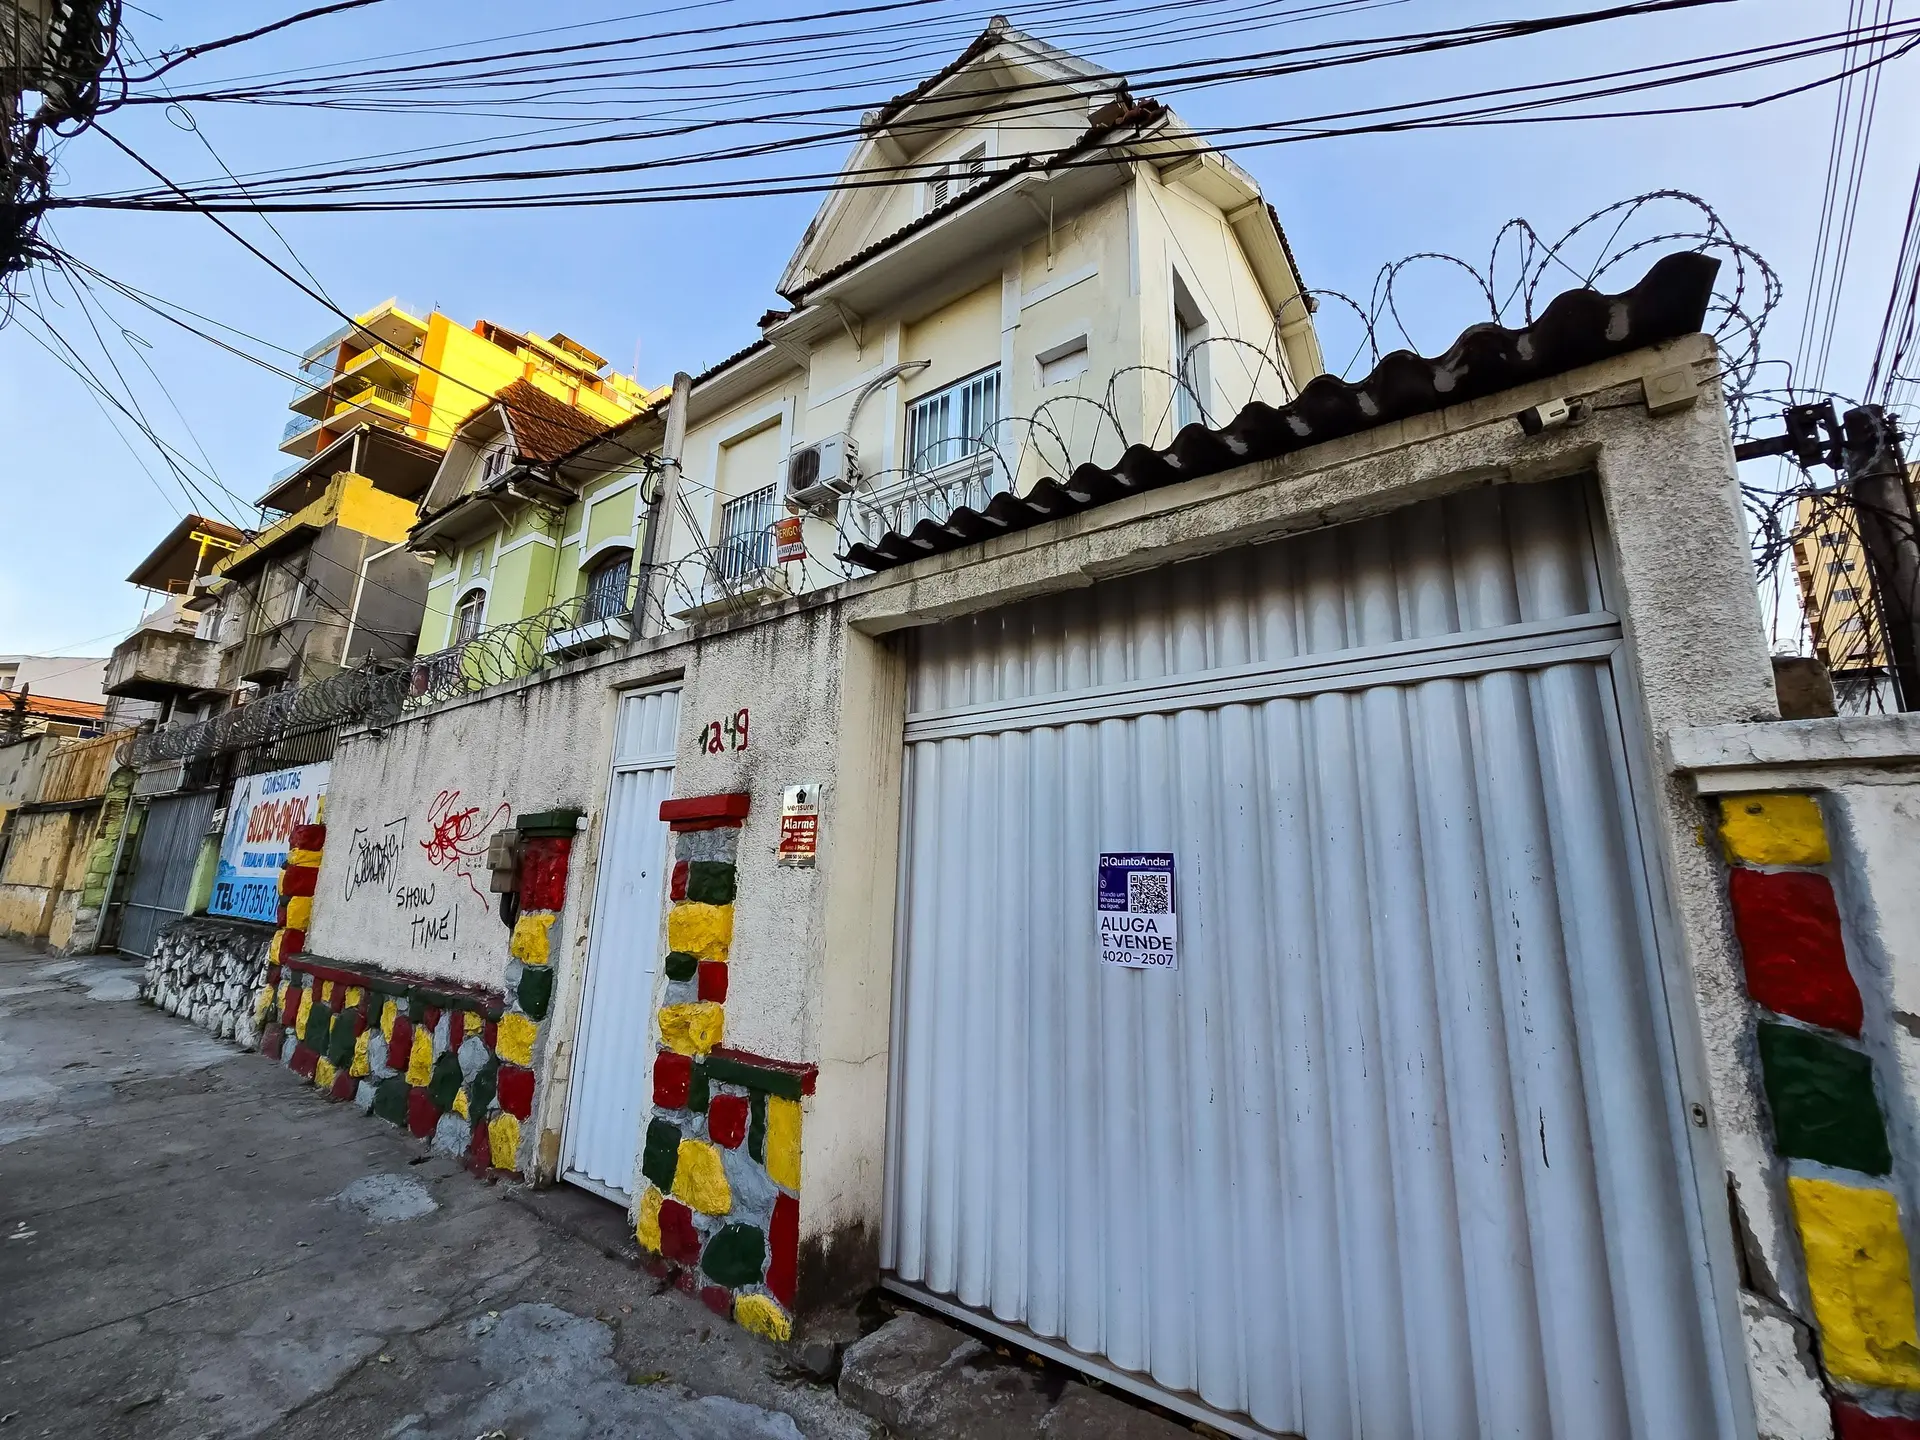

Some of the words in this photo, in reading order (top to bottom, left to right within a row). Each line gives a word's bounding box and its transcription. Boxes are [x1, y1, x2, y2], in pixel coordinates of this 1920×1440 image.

[698, 708, 749, 755] 1249
[262, 771, 302, 796] CONSULTAS
[783, 818, 815, 829] Alarme
[1109, 857, 1171, 867] QuintoAndar
[396, 882, 435, 910] SHOW
[1101, 916, 1159, 933] ALUGA
[1102, 933, 1110, 947] E
[1112, 933, 1174, 951] VENDE
[1102, 950, 1174, 966] 4020-2507
